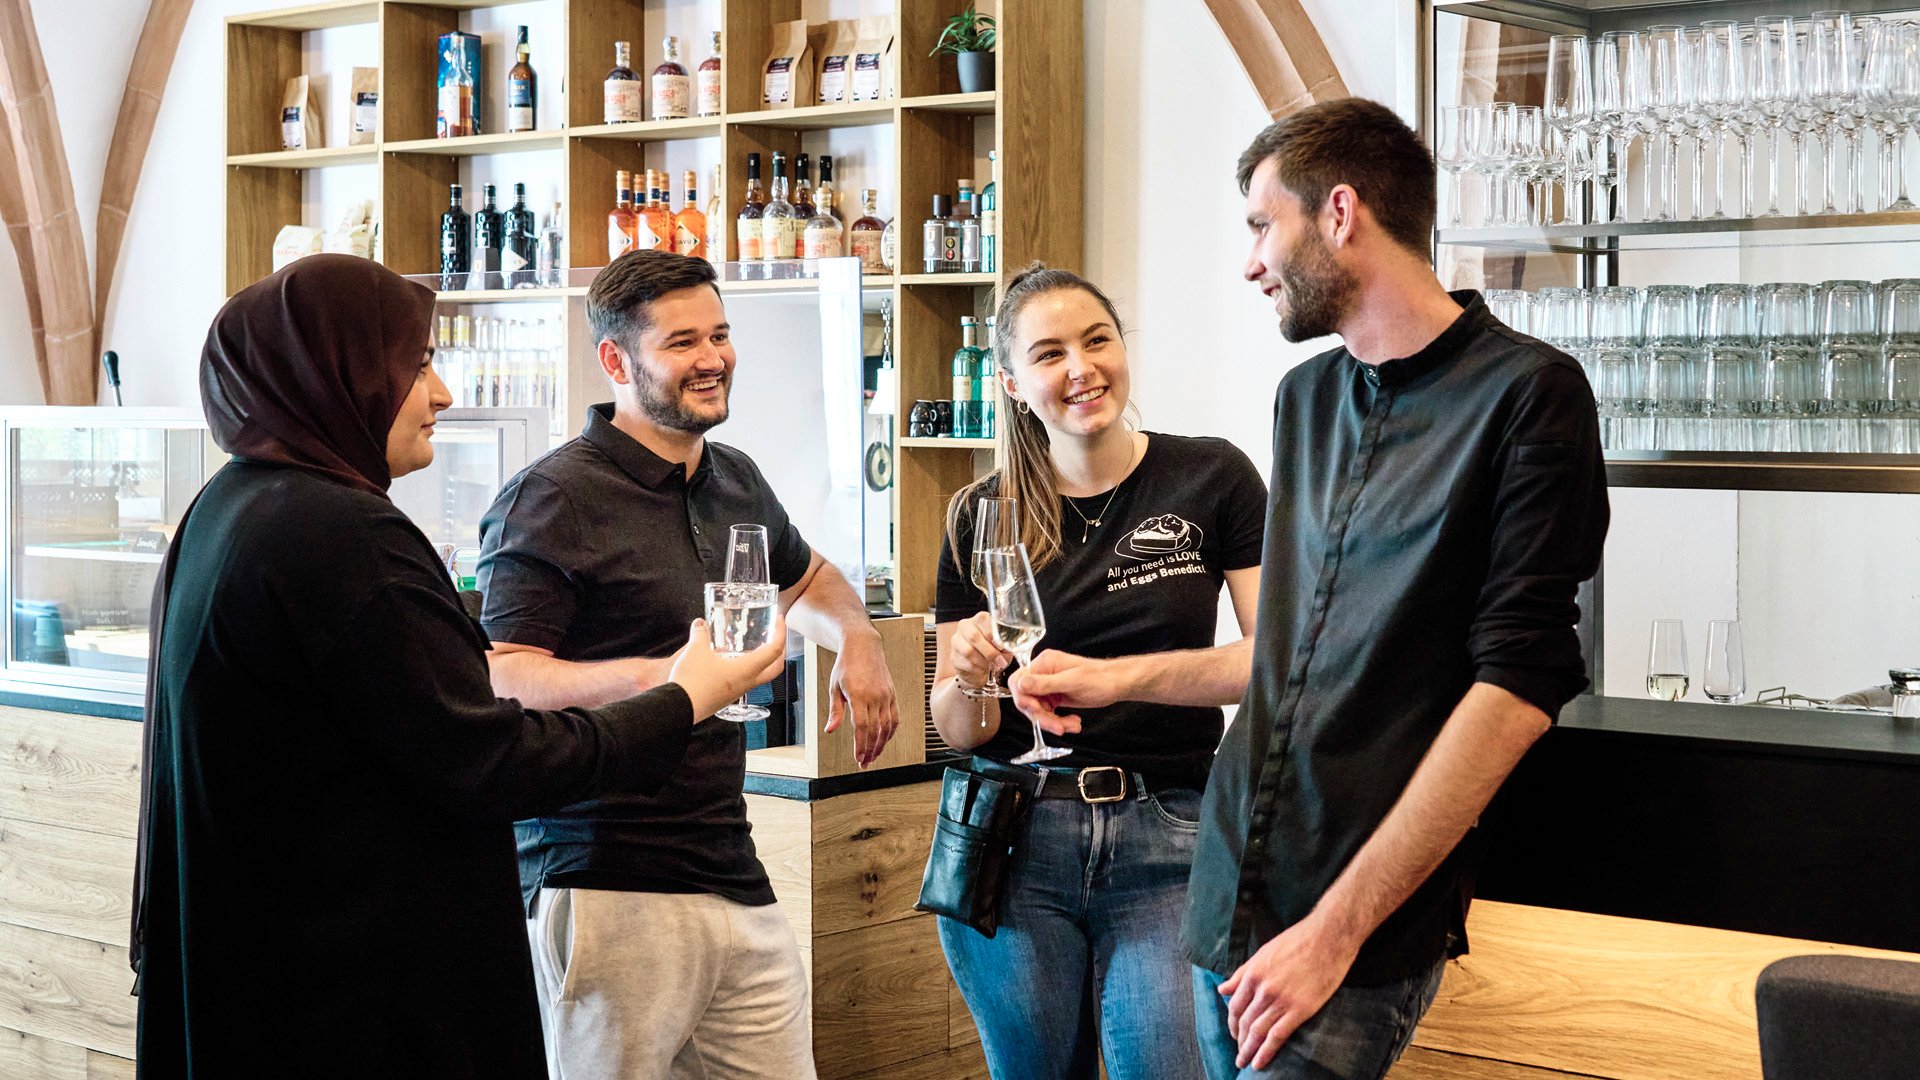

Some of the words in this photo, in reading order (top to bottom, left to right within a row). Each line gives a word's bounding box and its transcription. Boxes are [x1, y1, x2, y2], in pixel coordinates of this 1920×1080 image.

[1107, 567, 1120, 578] All
[1122, 566, 1139, 578] you
[1141, 558, 1164, 571] need
[1167, 555, 1175, 563] is
[1175, 551, 1201, 561] LOVE
[1107, 579, 1128, 592] and
[1130, 571, 1158, 585] Eggs
[1160, 564, 1206, 577] Benedict!
